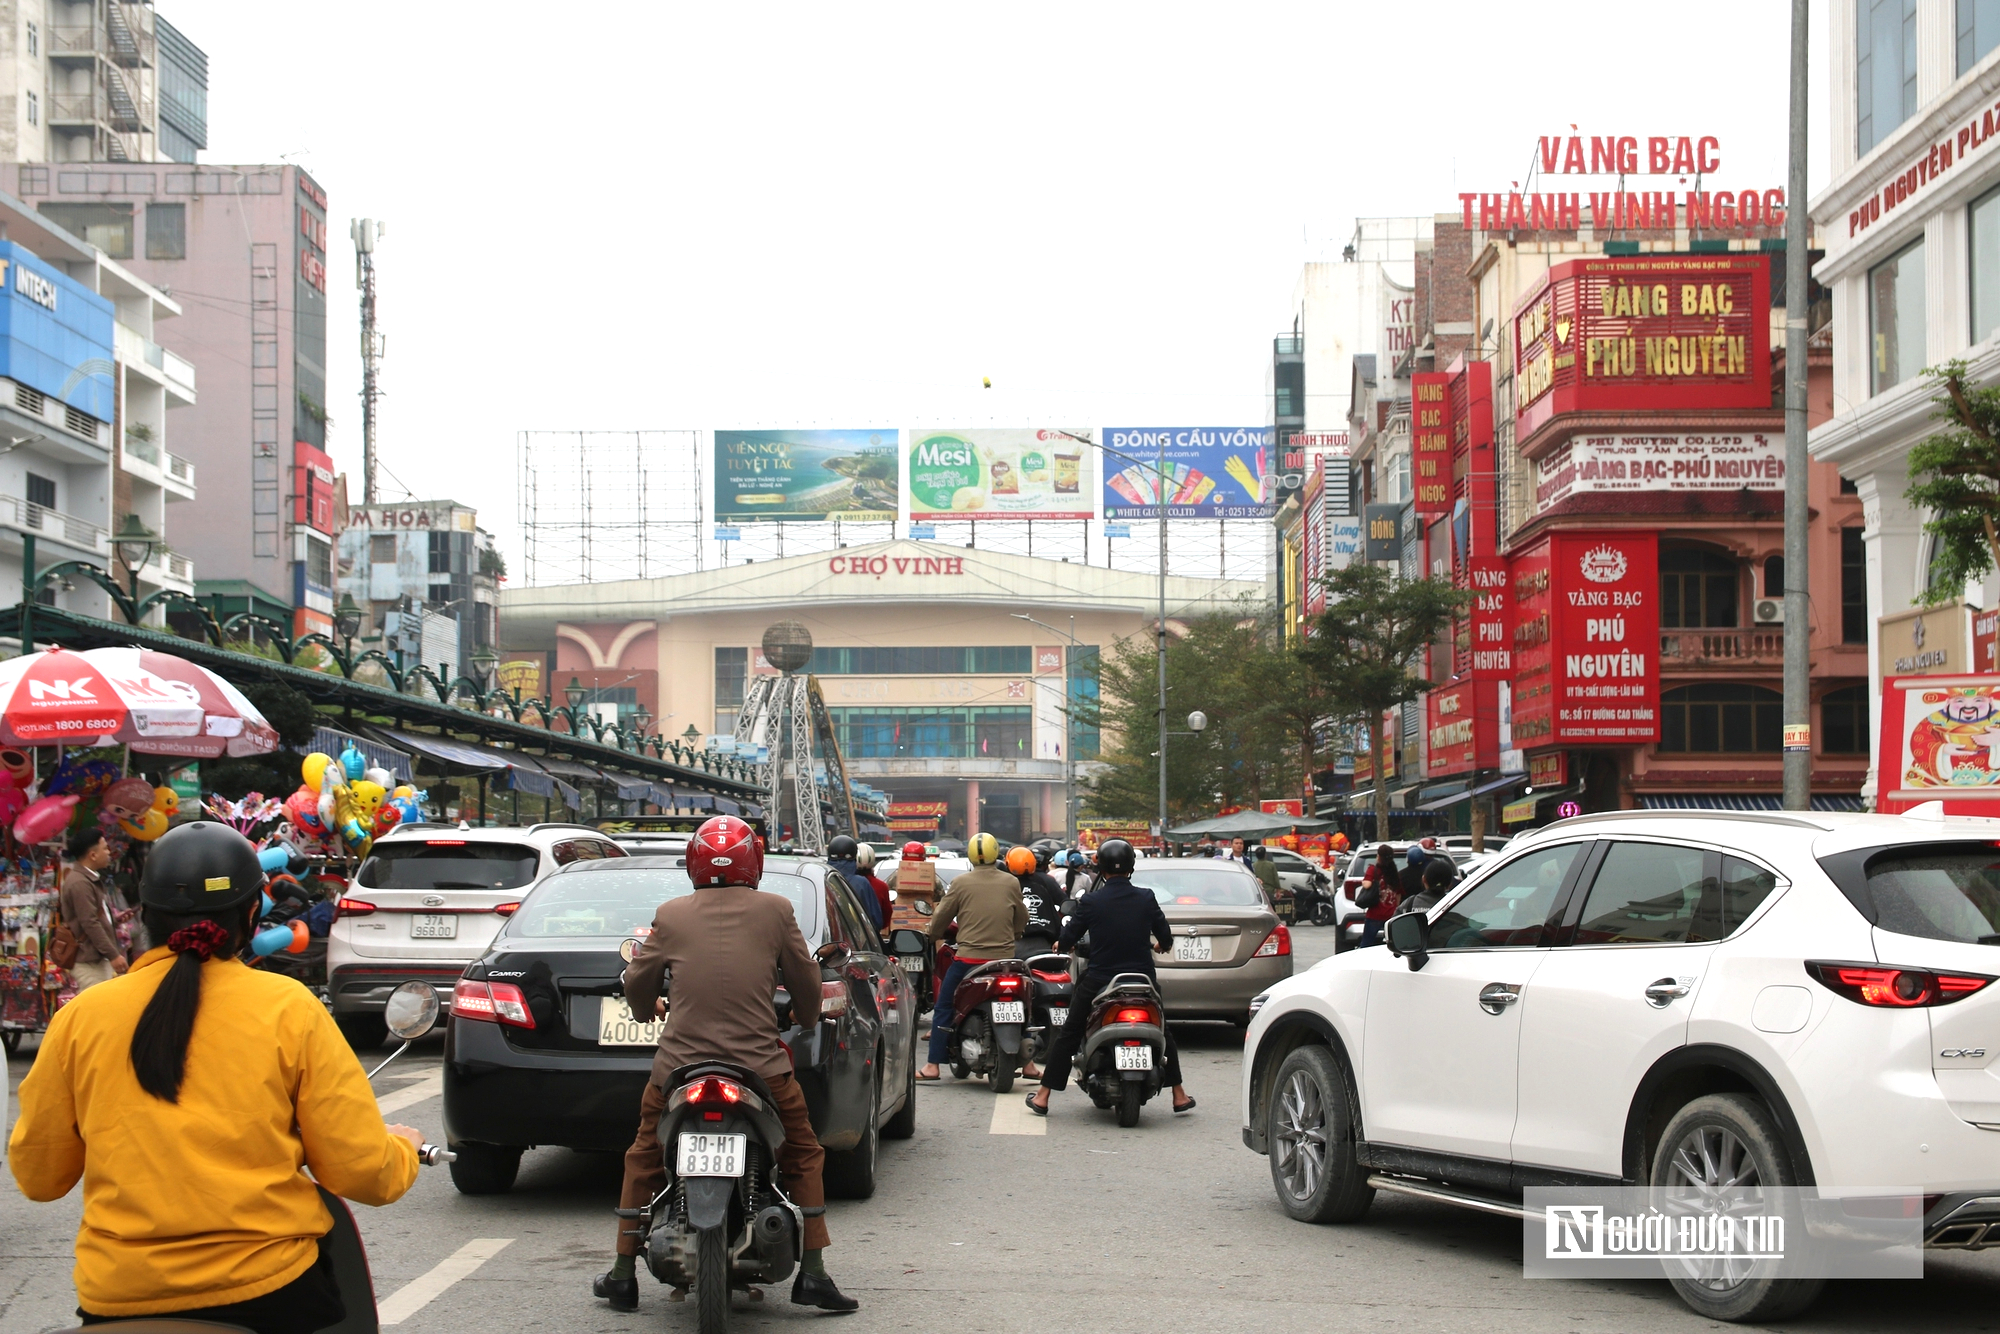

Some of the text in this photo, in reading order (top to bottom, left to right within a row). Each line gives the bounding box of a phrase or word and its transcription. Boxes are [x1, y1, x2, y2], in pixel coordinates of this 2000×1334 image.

[1540, 124, 1720, 184] VÀNG BẠC
[1884, 138, 1953, 213] NGUYÊN
[1458, 181, 1785, 238] THÀNH VINH NGỌC
[16, 264, 57, 312] INTECH
[1600, 278, 1733, 322] VÀNG BẠC
[1586, 327, 1745, 377] PHÚ NGUYÊN
[1417, 382, 1443, 402] VÀNG
[727, 440, 757, 454] VIÊN
[1112, 430, 1171, 447] ĐÔNG
[1176, 428, 1215, 447] CẦU
[1289, 431, 1317, 446] KÍNH
[918, 443, 972, 467] Mesi
[1419, 485, 1446, 505] NGỌC
[1117, 508, 1141, 517] WHITE
[1229, 507, 1246, 517] 0251
[1334, 523, 1359, 539] Long
[1334, 541, 1357, 554] Như
[829, 554, 964, 581] CHỢ VINH
[1473, 567, 1506, 588] VÀNG
[1567, 588, 1642, 609] VÀNG BẠC
[1479, 618, 1503, 641] PHÚ
[1586, 613, 1625, 642] PHÚ
[1473, 647, 1510, 670] NGUYÊN
[1566, 648, 1645, 678] NGUYÊN
[28, 676, 97, 699] NK
[1583, 709, 1591, 719] 17
[1617, 709, 1631, 720] CAO
[17, 719, 116, 732] HOTLINE: 1800 6800
[424, 915, 443, 926] 37A
[416, 926, 451, 937] 968.00
[1183, 936, 1203, 948] 37A
[1177, 949, 1211, 961] 194.27
[487, 970, 527, 978] CAMRY
[995, 1012, 1023, 1022] 990.58
[996, 1003, 1019, 1012] 37-F1
[1120, 1047, 1147, 1058] 37-K4
[1940, 1047, 1986, 1058] CX-5
[1121, 1058, 1148, 1069] 0368
[688, 1135, 735, 1154] 30-H1
[686, 1154, 735, 1173] 8388
